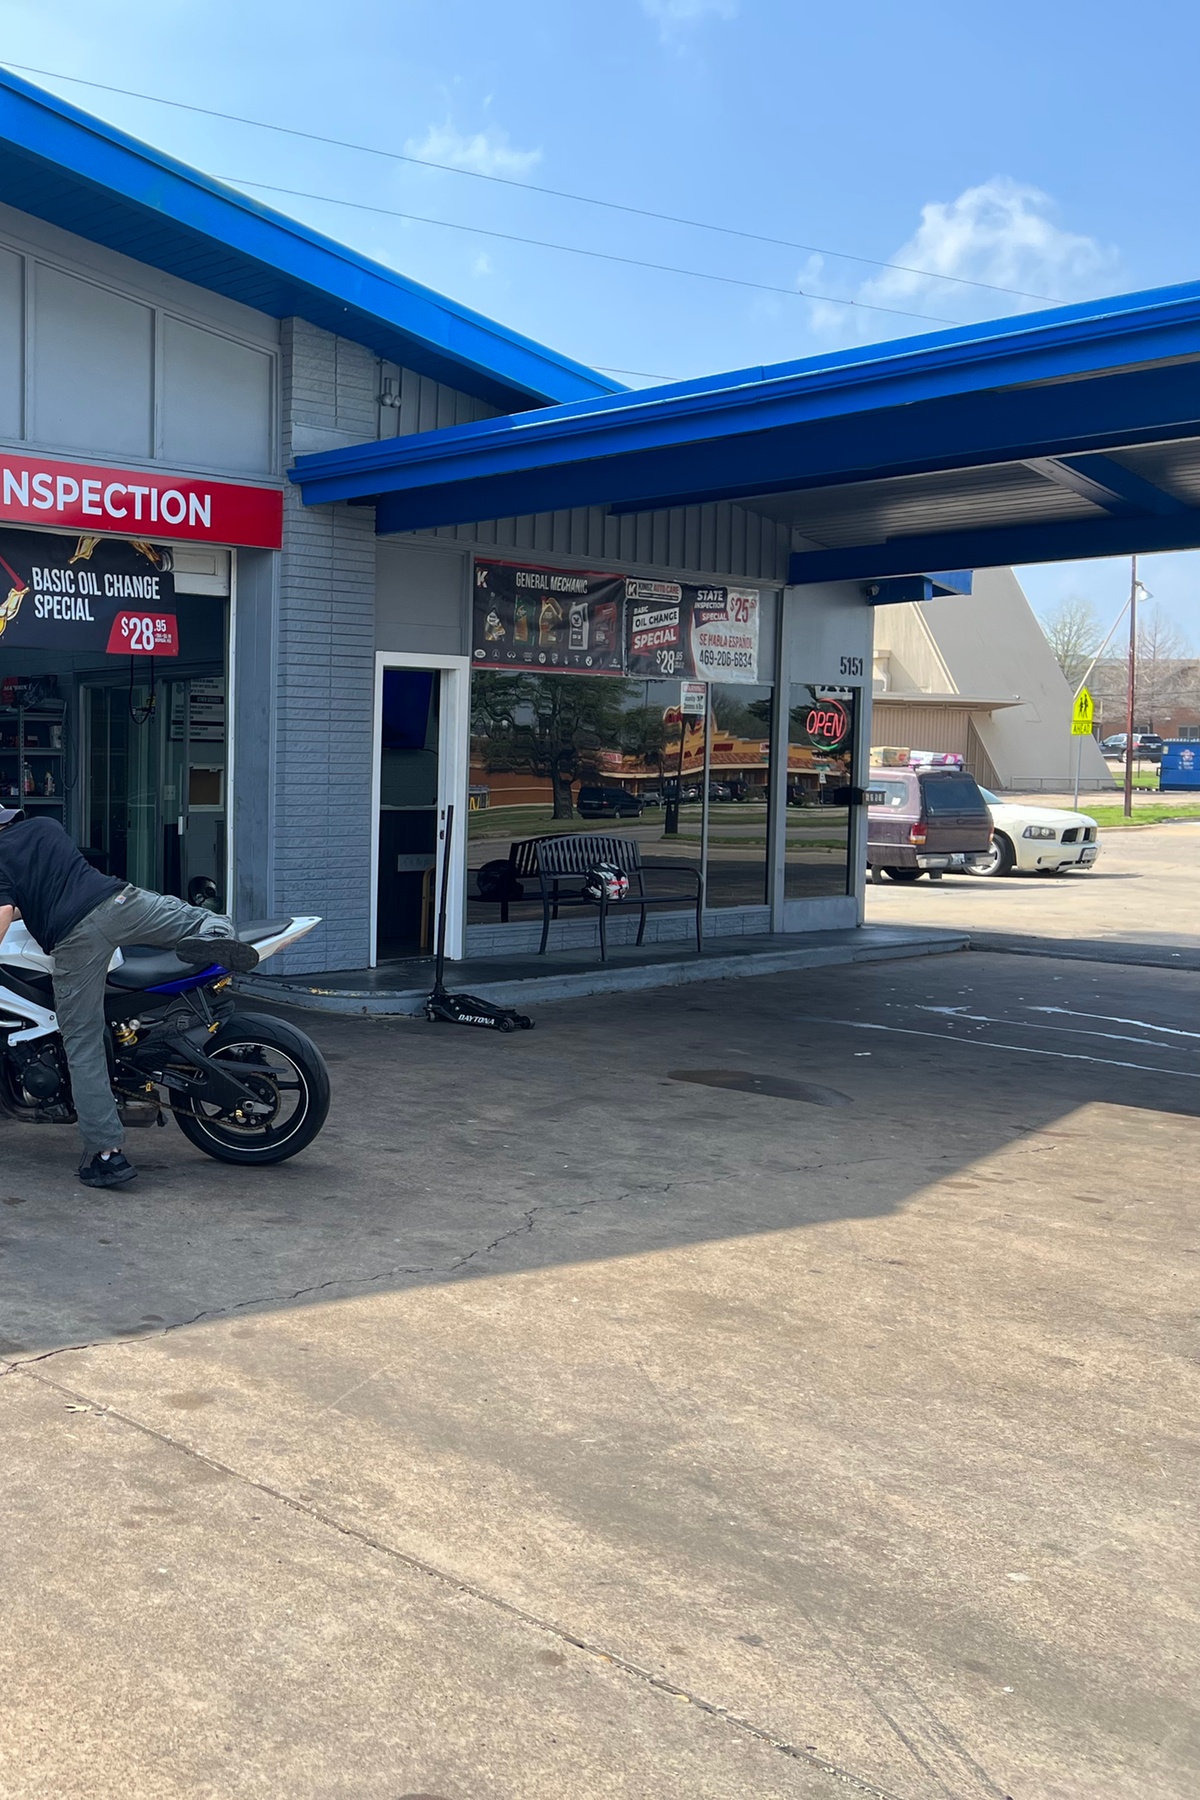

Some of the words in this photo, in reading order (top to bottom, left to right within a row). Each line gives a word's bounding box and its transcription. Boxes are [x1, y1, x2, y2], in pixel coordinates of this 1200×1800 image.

[32, 567, 74, 593] BASIC
[79, 572, 101, 595] OIL
[104, 574, 160, 599] CHANGE
[516, 572, 549, 589] GENERAL
[550, 576, 587, 593] MECHANIC
[654, 584, 665, 593] AUTO
[666, 585, 679, 594] CARE
[697, 590, 723, 600] STATE
[35, 594, 94, 621] SPECIAL
[634, 606, 648, 614] BASIC
[635, 618, 647, 628] OIL
[649, 611, 677, 624] CHANGE
[702, 612, 727, 621] SPECIAL
[634, 628, 676, 649] SPECIAL
[700, 633, 708, 646] SE
[709, 634, 727, 647] HABLA
[729, 635, 752, 649] ESPAÑOL
[700, 650, 752, 667] 469-206-6834
[840, 656, 863, 676] 5151
[806, 710, 844, 737] OPEN
[1073, 724, 1090, 733] AHEAD
[458, 1014, 495, 1025] DAYTONA
